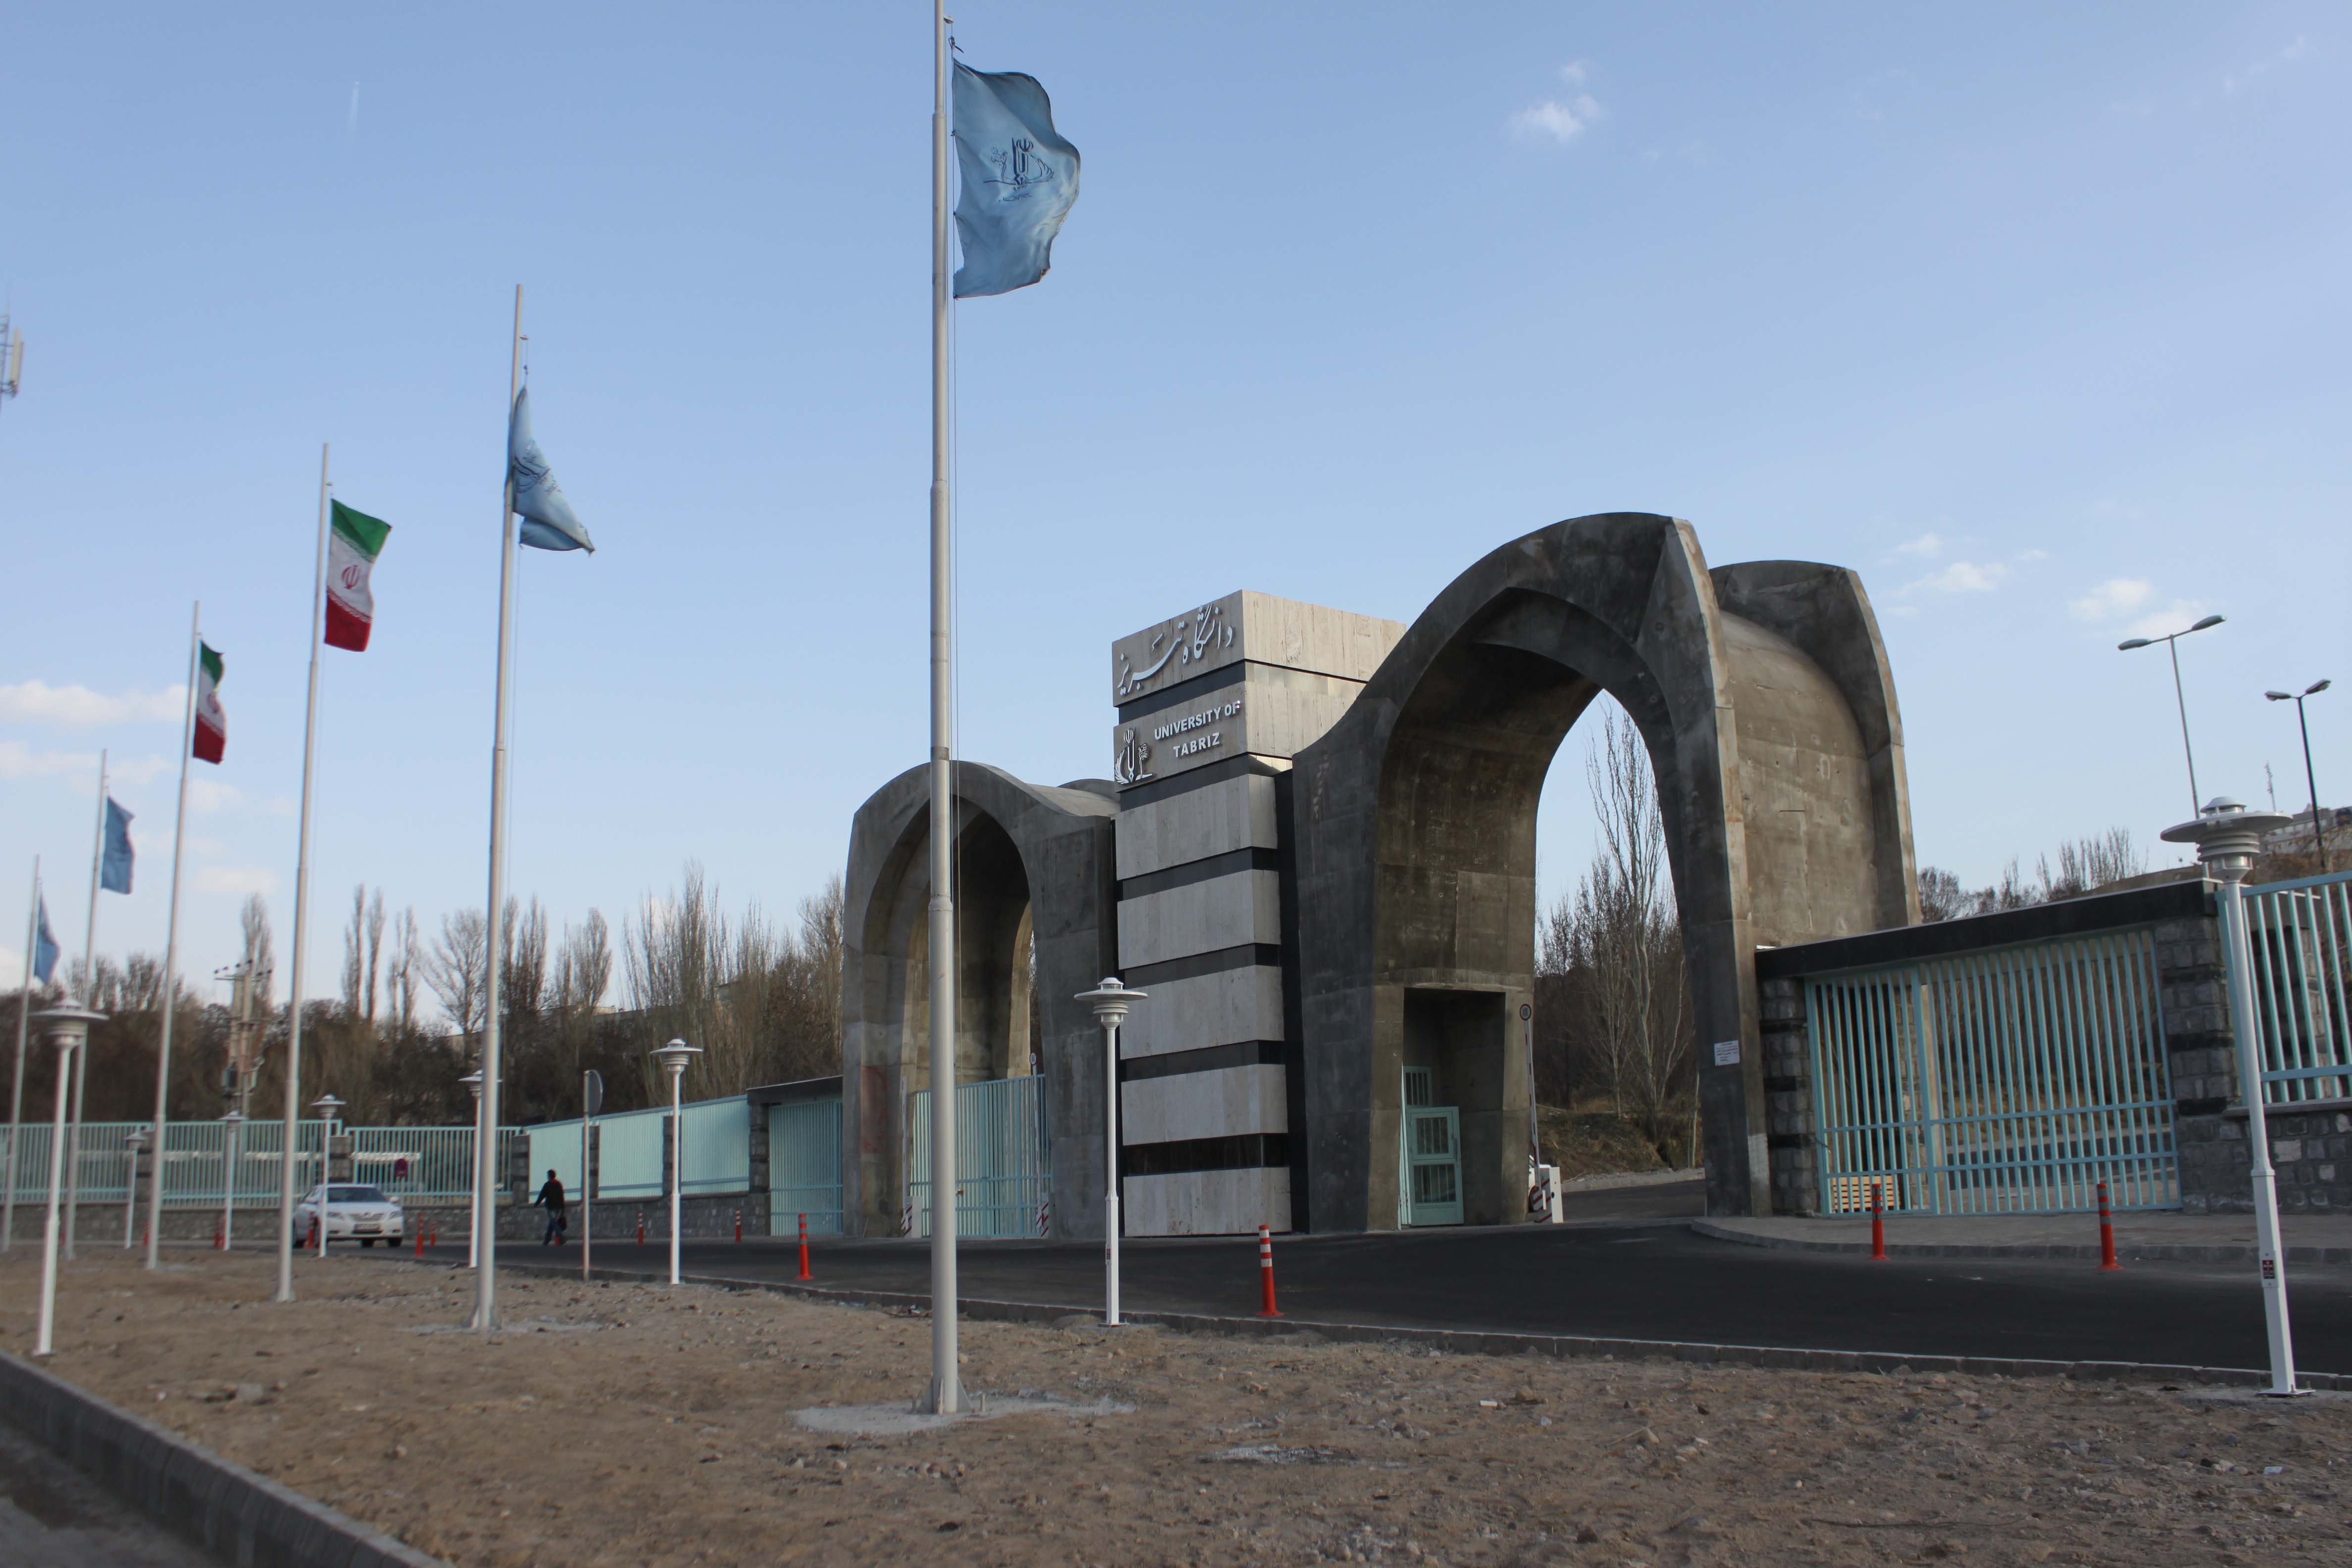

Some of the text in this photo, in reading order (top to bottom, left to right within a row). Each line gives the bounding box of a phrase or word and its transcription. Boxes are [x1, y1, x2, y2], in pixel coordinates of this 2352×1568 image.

[1117, 603, 1233, 695] دانشگاه تبریز
[1154, 700, 1240, 740] UNIVERSITY OF
[1173, 732, 1220, 758] TABRIZ
